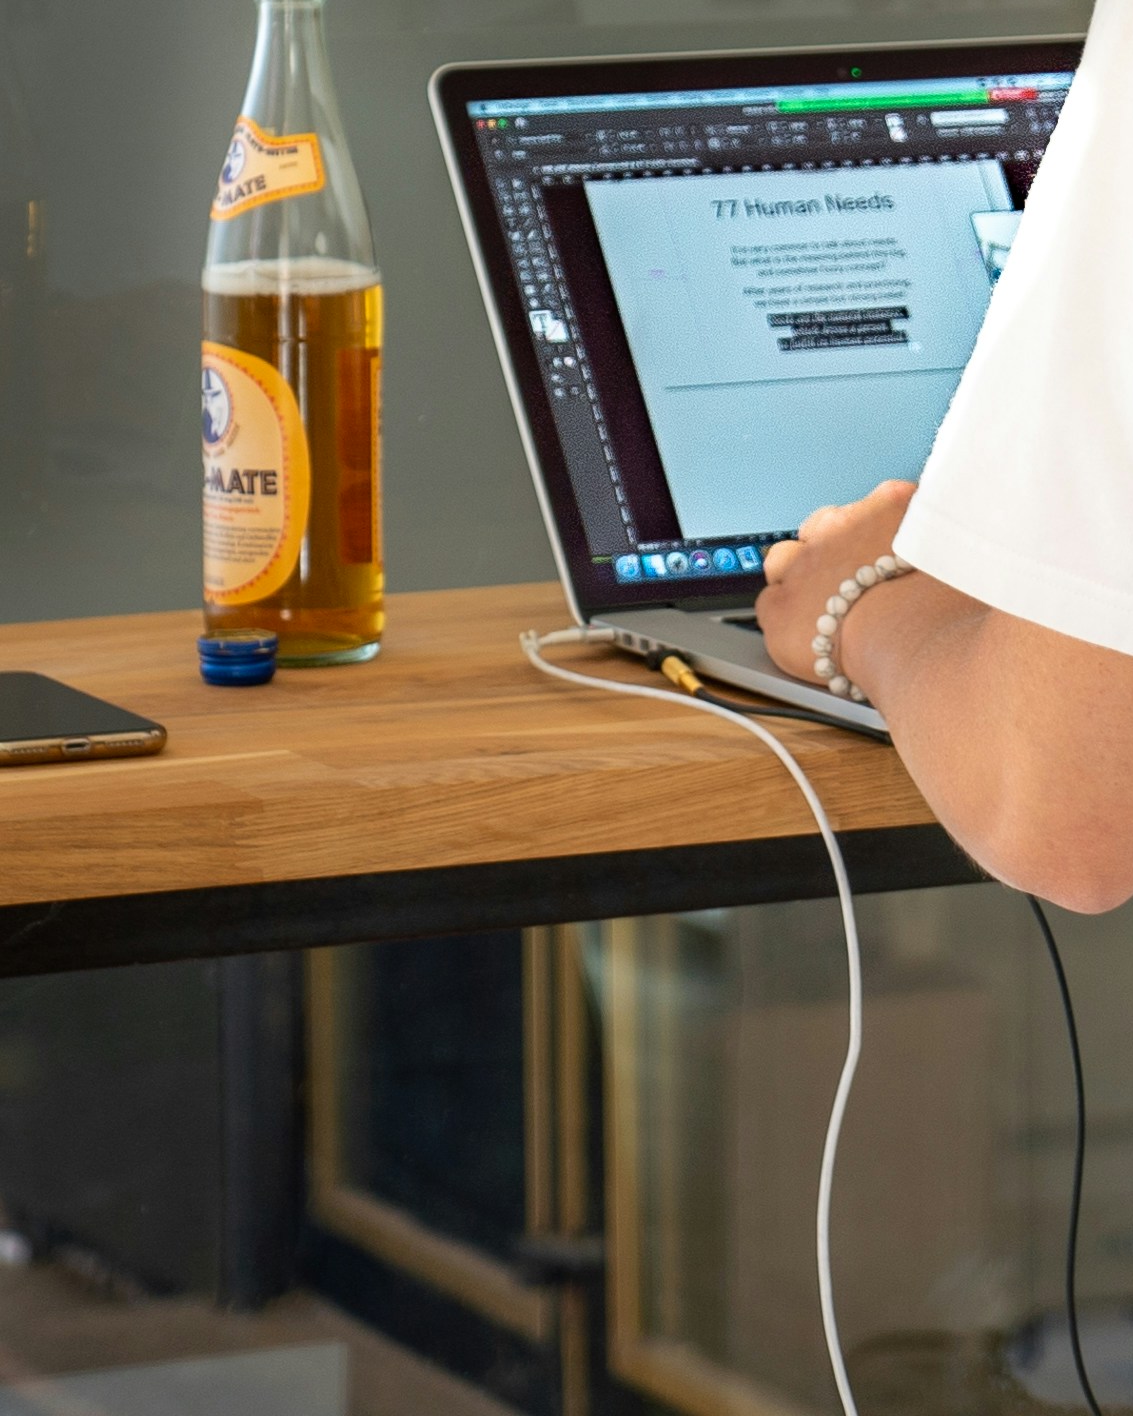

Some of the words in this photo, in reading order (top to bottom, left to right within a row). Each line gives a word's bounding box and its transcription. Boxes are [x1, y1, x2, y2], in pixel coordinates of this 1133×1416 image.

[711, 198, 738, 219] 77
[743, 197, 822, 219] Human
[824, 191, 896, 214] Needs
